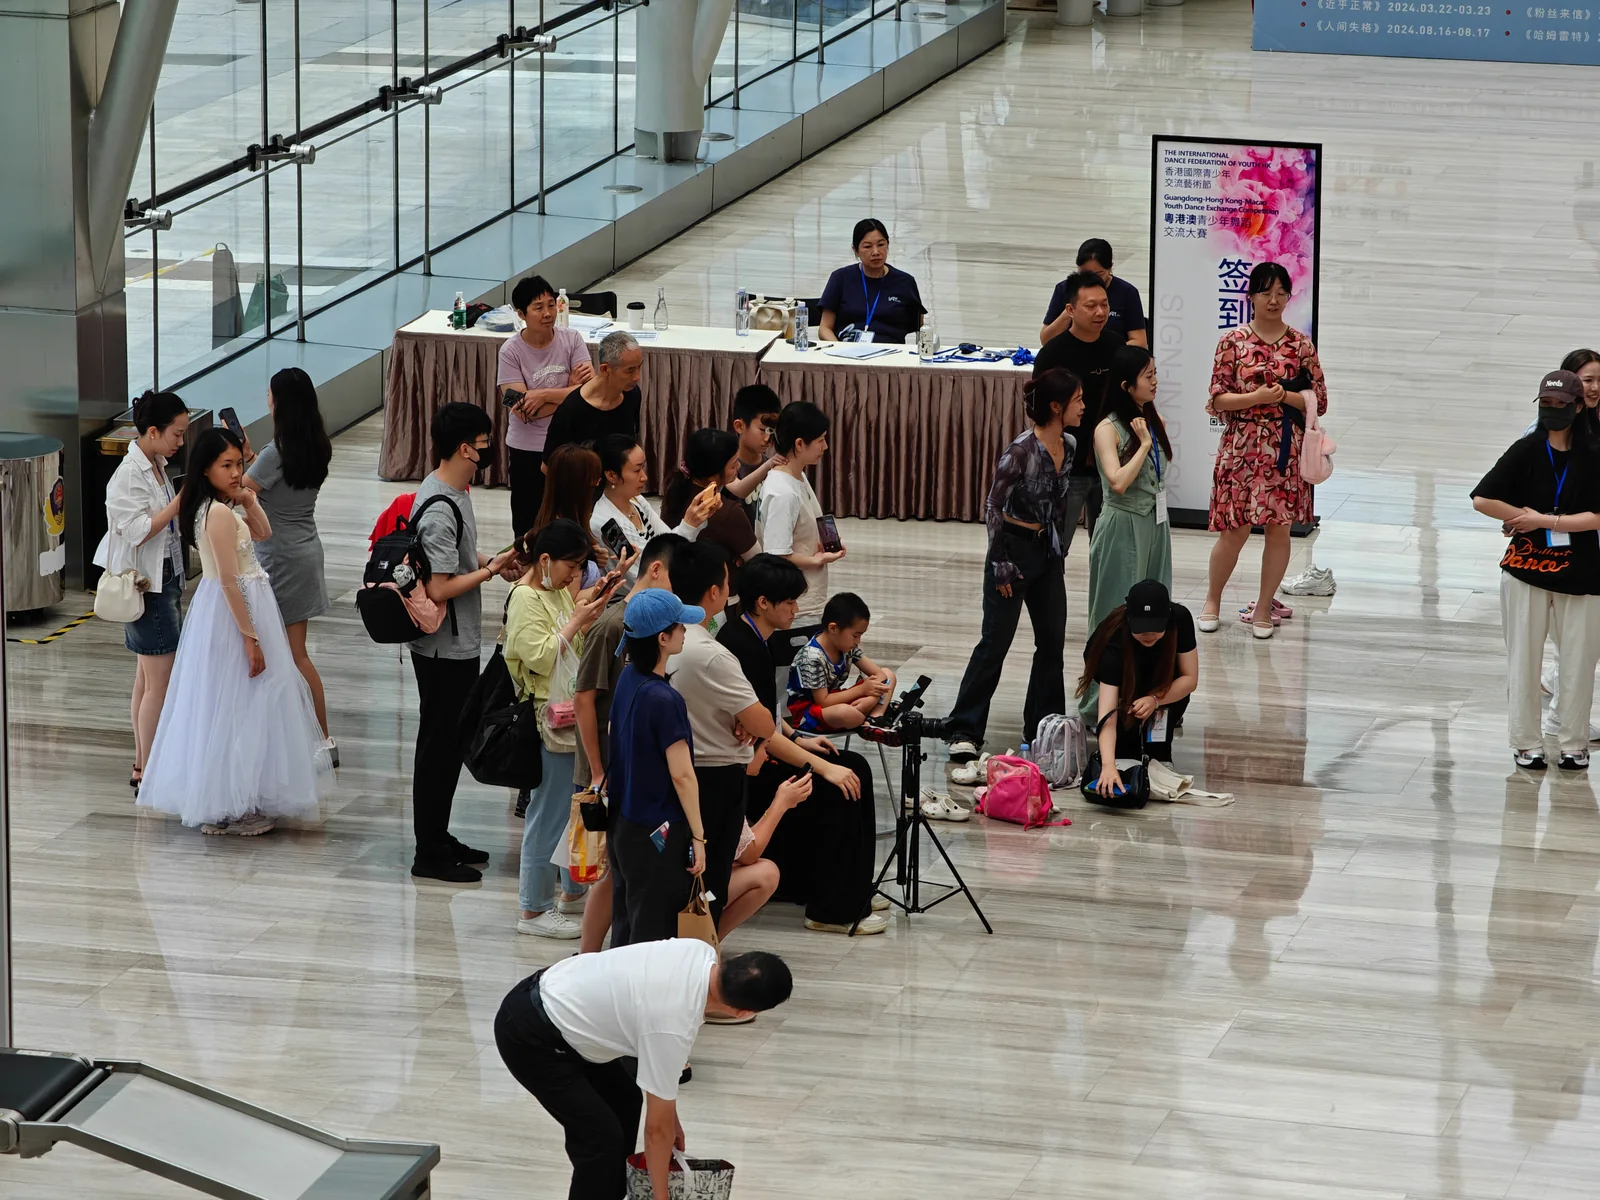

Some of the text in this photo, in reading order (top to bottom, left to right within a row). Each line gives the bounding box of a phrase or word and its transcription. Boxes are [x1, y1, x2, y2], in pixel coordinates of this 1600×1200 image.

[1387, 2, 1491, 16] 2024.03.22-03.23
[1526, 7, 1591, 20] 《粉丝来信》
[1316, 20, 1490, 38] 《人间失格》 2024.08.16-08.17
[1525, 29, 1590, 42] 《哈姆雷特》
[1164, 156, 1186, 164] DANCE
[1187, 158, 1227, 166] FEDERATION
[1164, 167, 1230, 179] 香港國際青少年
[1164, 178, 1212, 189] 交流藝術節
[1164, 194, 1267, 206] Guangdong-Hong Kong-Macao
[1164, 202, 1279, 215] Youth Dance Exchange Competition
[1164, 227, 1208, 239] 交流大賽
[1159, 294, 1184, 409] SIGN-IN
[1500, 544, 1570, 573] Dance
